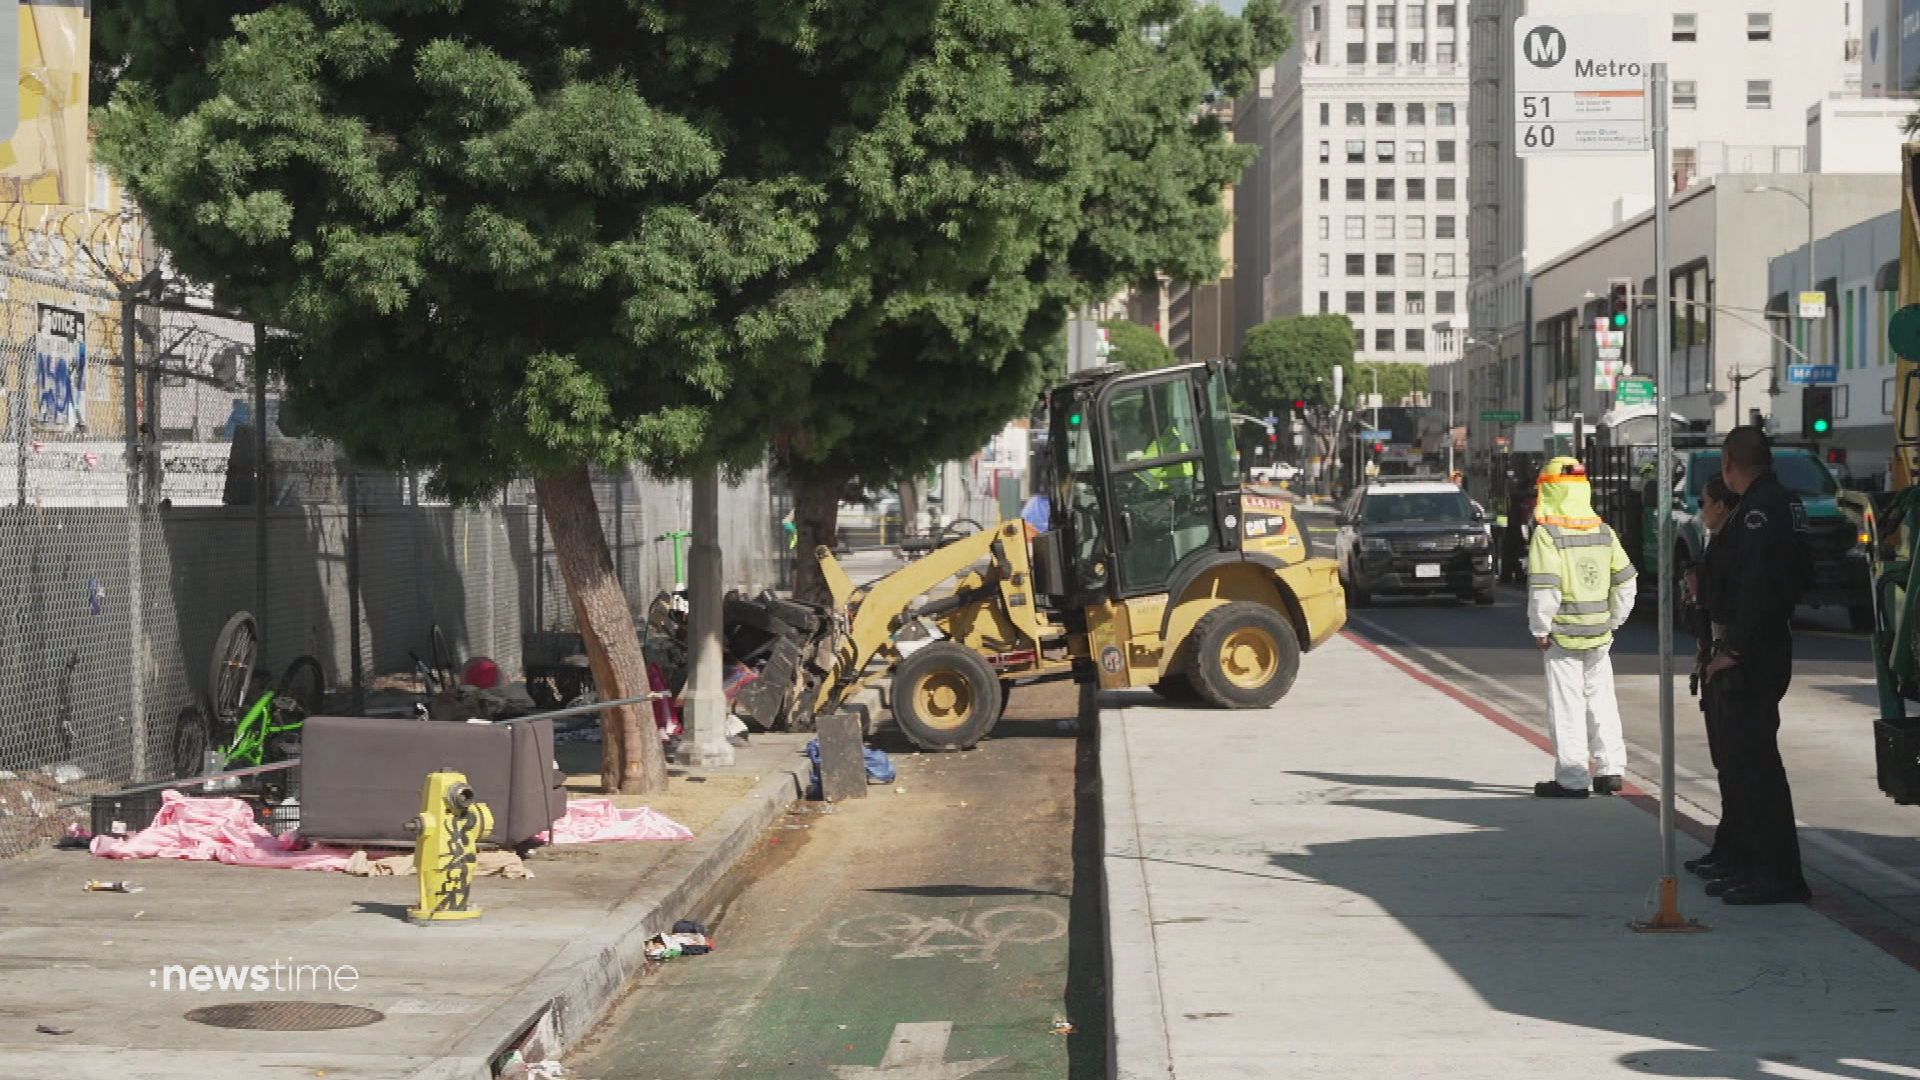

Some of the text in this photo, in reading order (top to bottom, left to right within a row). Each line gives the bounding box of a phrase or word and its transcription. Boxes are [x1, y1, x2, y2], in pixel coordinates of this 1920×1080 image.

[1529, 31, 1560, 63] M
[1575, 59, 1641, 78] Metro
[1523, 96, 1550, 118] 51
[1524, 124, 1555, 148] 60
[1245, 519, 1266, 536] CAT
